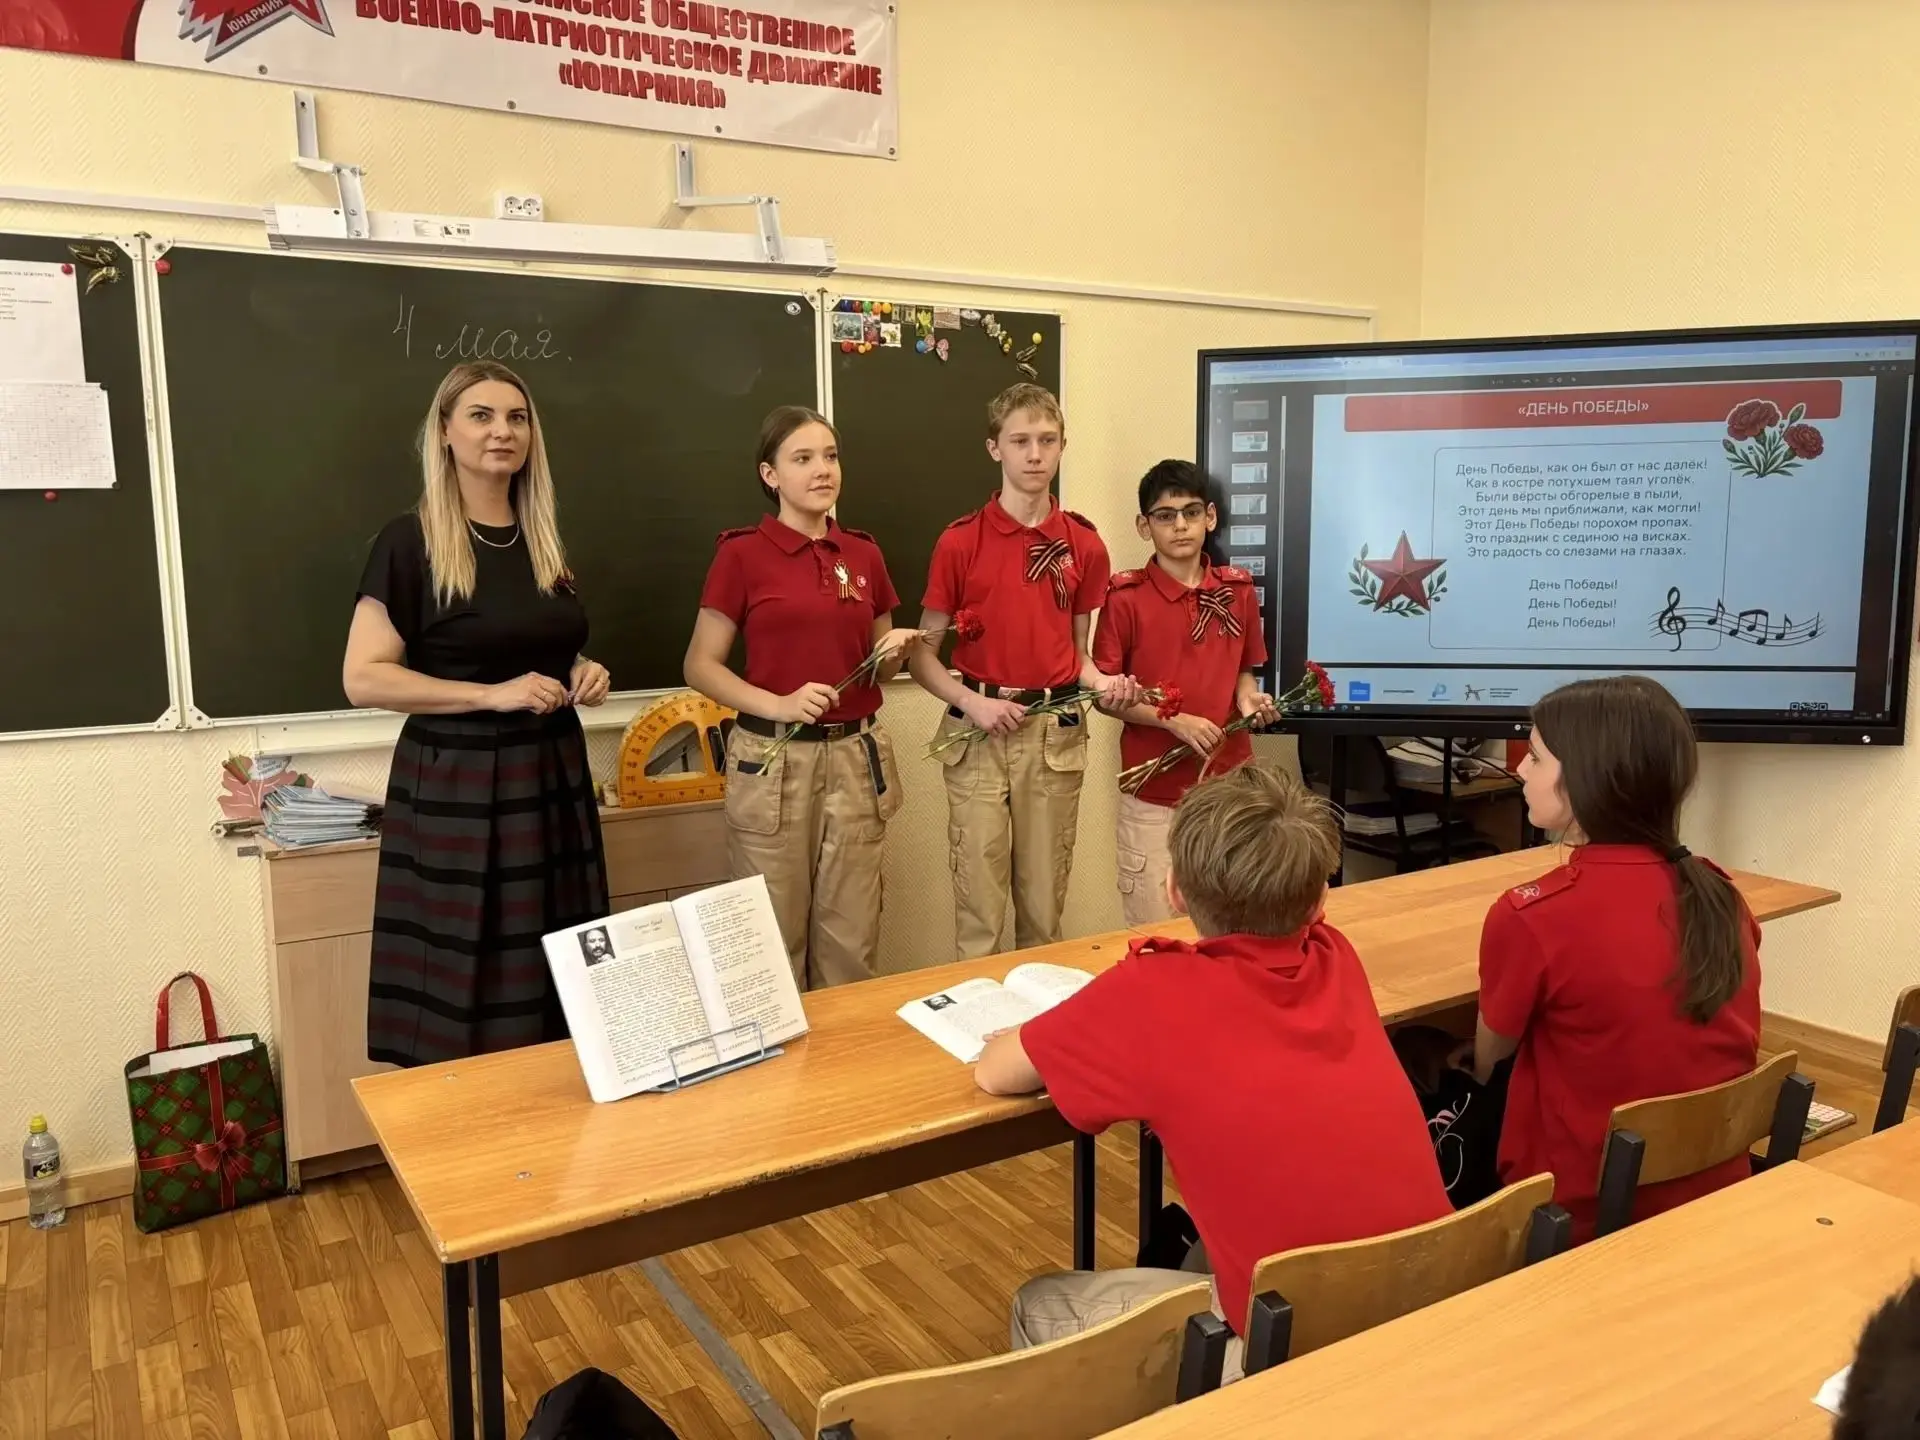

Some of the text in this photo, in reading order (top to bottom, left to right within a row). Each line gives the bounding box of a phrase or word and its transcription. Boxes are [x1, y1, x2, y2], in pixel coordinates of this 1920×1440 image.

[226, 0, 284, 33] ЮНАРМИЯ
[651, 0, 857, 56] ОБЩЕСТВЕННОЕ
[355, 0, 882, 95] ВОЕННО-ПАТРИОТИЧЕСКОЕ ДВИЖЕНИЕ
[558, 58, 727, 109] «ЮНАРМИЯ»
[393, 294, 415, 358] 4
[1518, 399, 1650, 417] «ДЕНЬ ПОБЕДЫ»
[1456, 458, 1708, 477] День Победы, как он был от нас далёк!
[1466, 473, 1695, 490] Как в костре потухшем таял уголёк.
[1476, 491, 1509, 502] Были
[1560, 490, 1630, 502] обгорелые
[1633, 491, 1641, 500] в
[1644, 490, 1682, 500] пыли,
[1458, 502, 1701, 517] Этот день мы приближали, как могли!
[1465, 518, 1692, 531] Этот День Победы порохом пропах.
[1465, 532, 1691, 545] Это праздник с сединою на висках.
[1467, 546, 1687, 559] Это радость со слезами на глазах.
[1529, 578, 1618, 591] День Победы!
[1528, 597, 1617, 610] День Победы!
[1527, 616, 1616, 629] День Победы!
